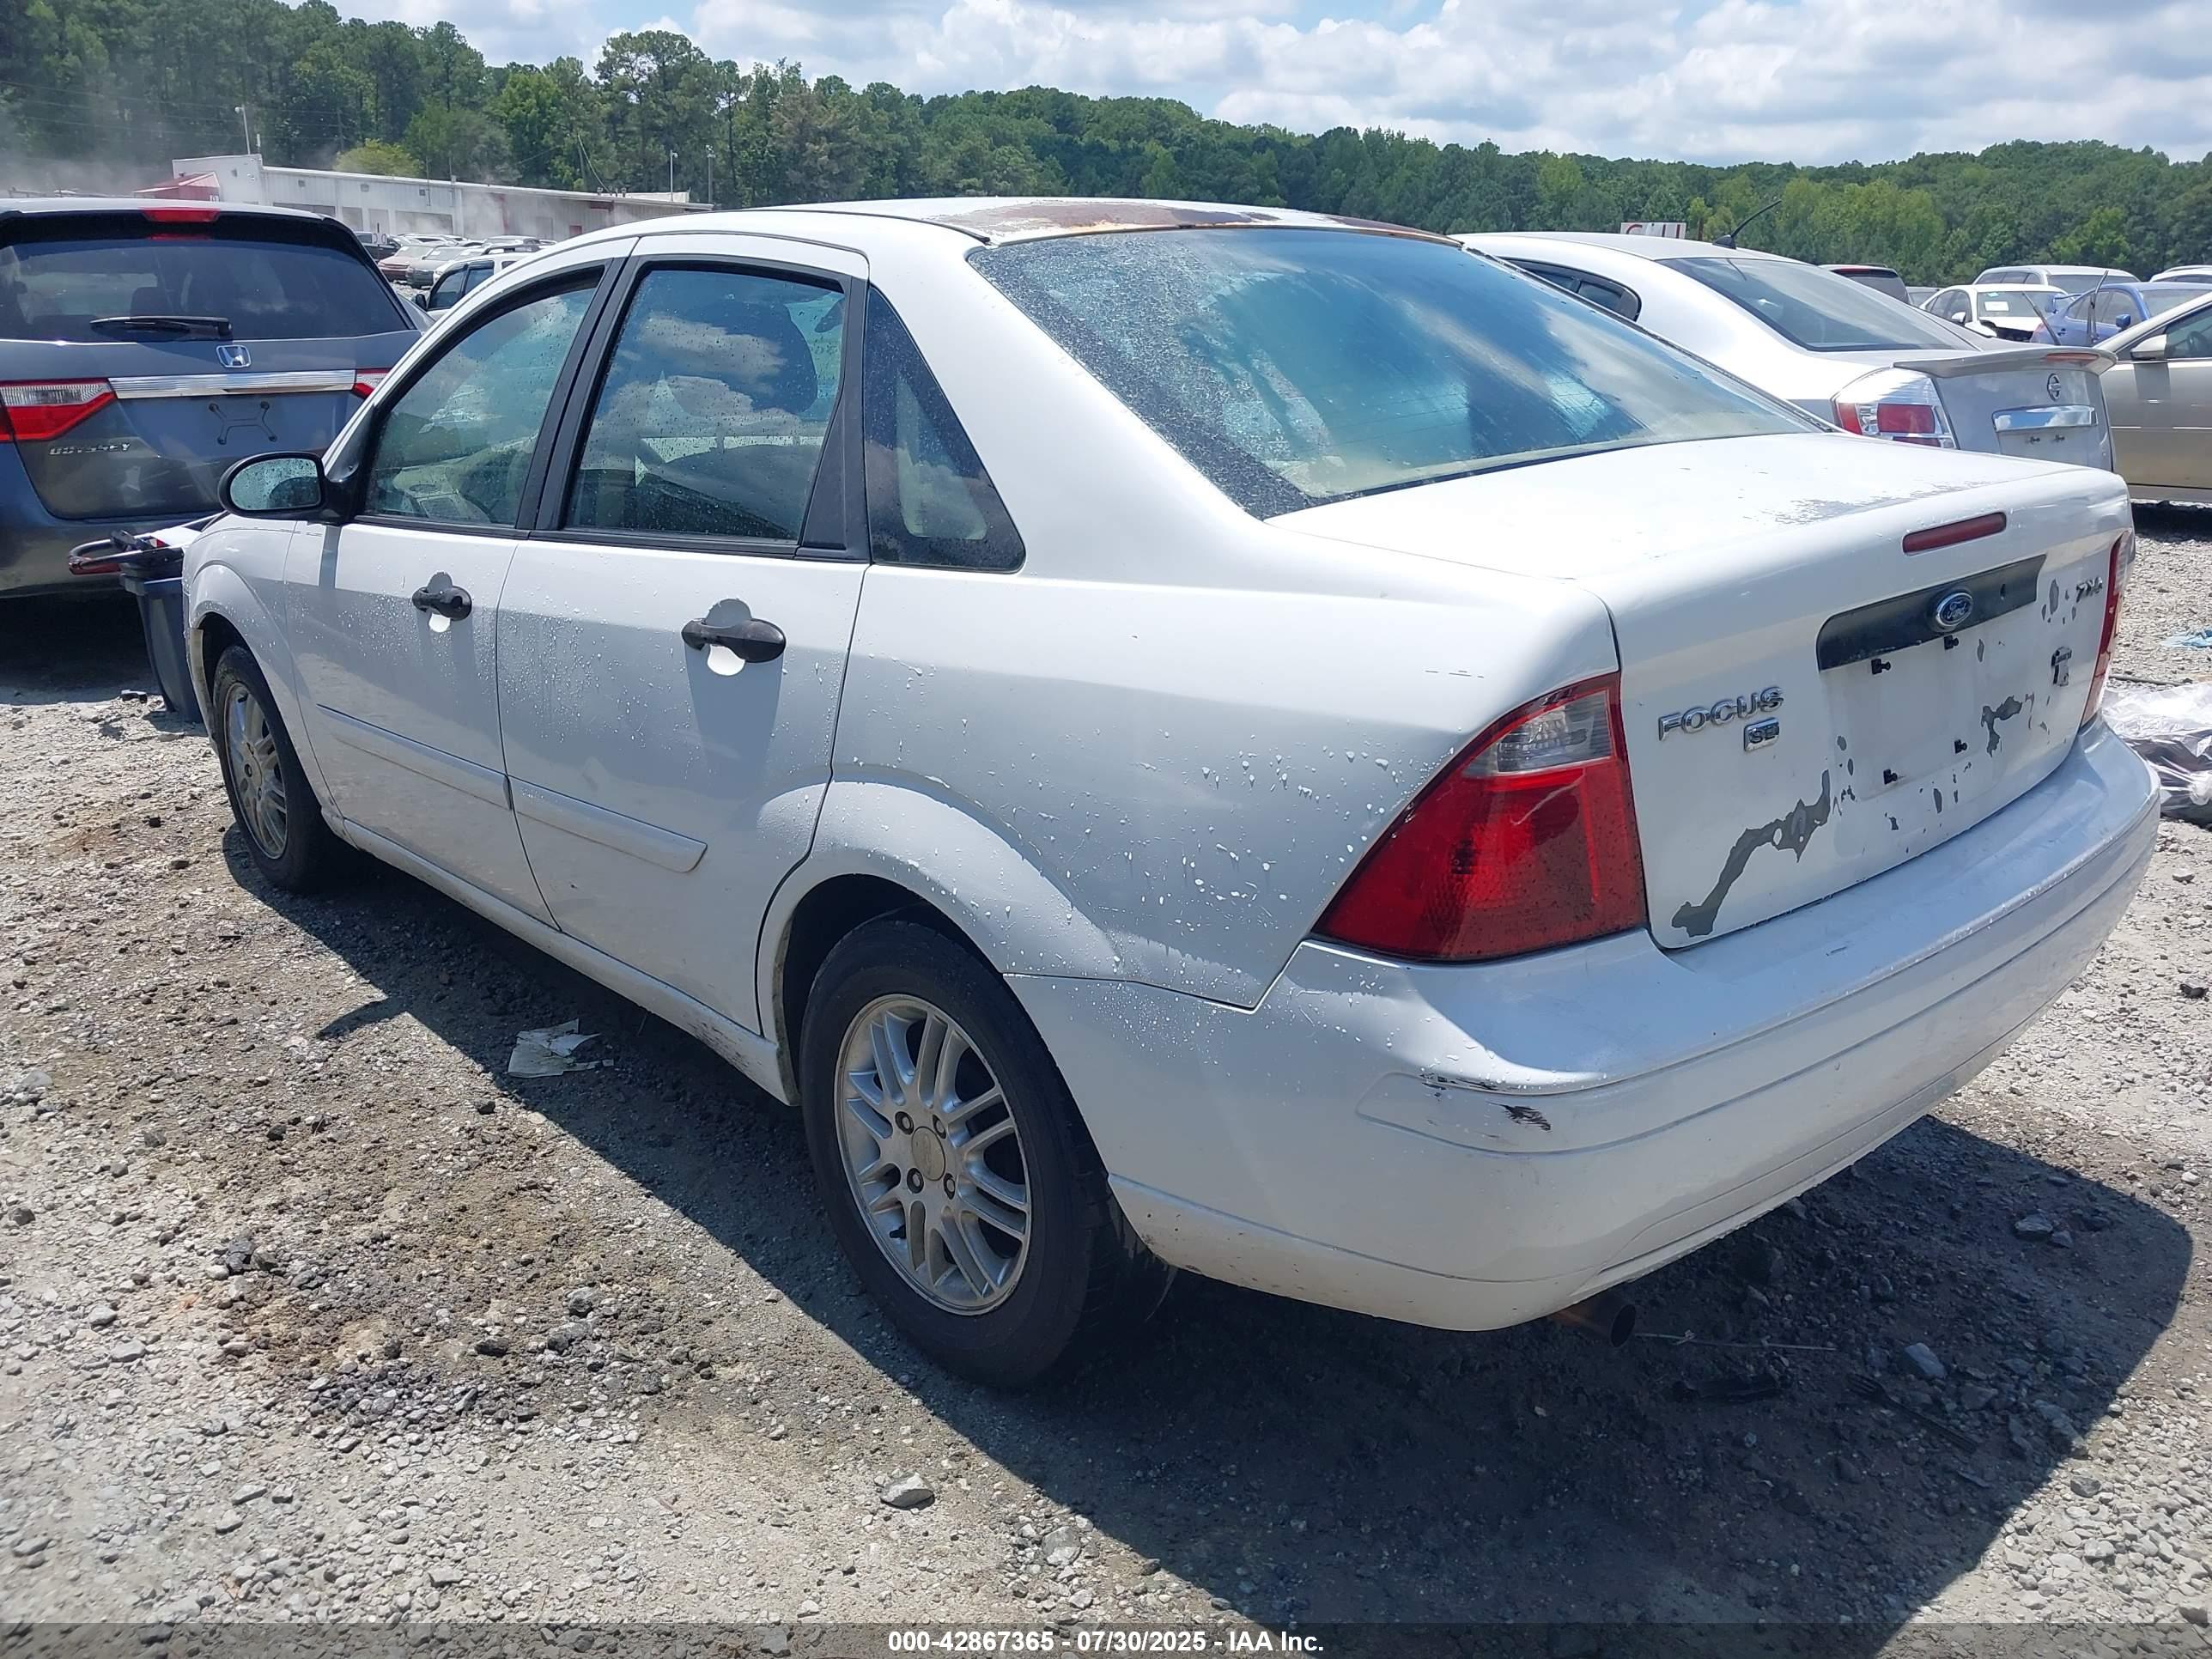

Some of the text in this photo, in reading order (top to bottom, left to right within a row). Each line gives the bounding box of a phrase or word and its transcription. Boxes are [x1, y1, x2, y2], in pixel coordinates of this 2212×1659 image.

[1943, 599, 1968, 620] Ford
[1658, 685, 1785, 741] FOCUS
[1748, 721, 1780, 745] SE
